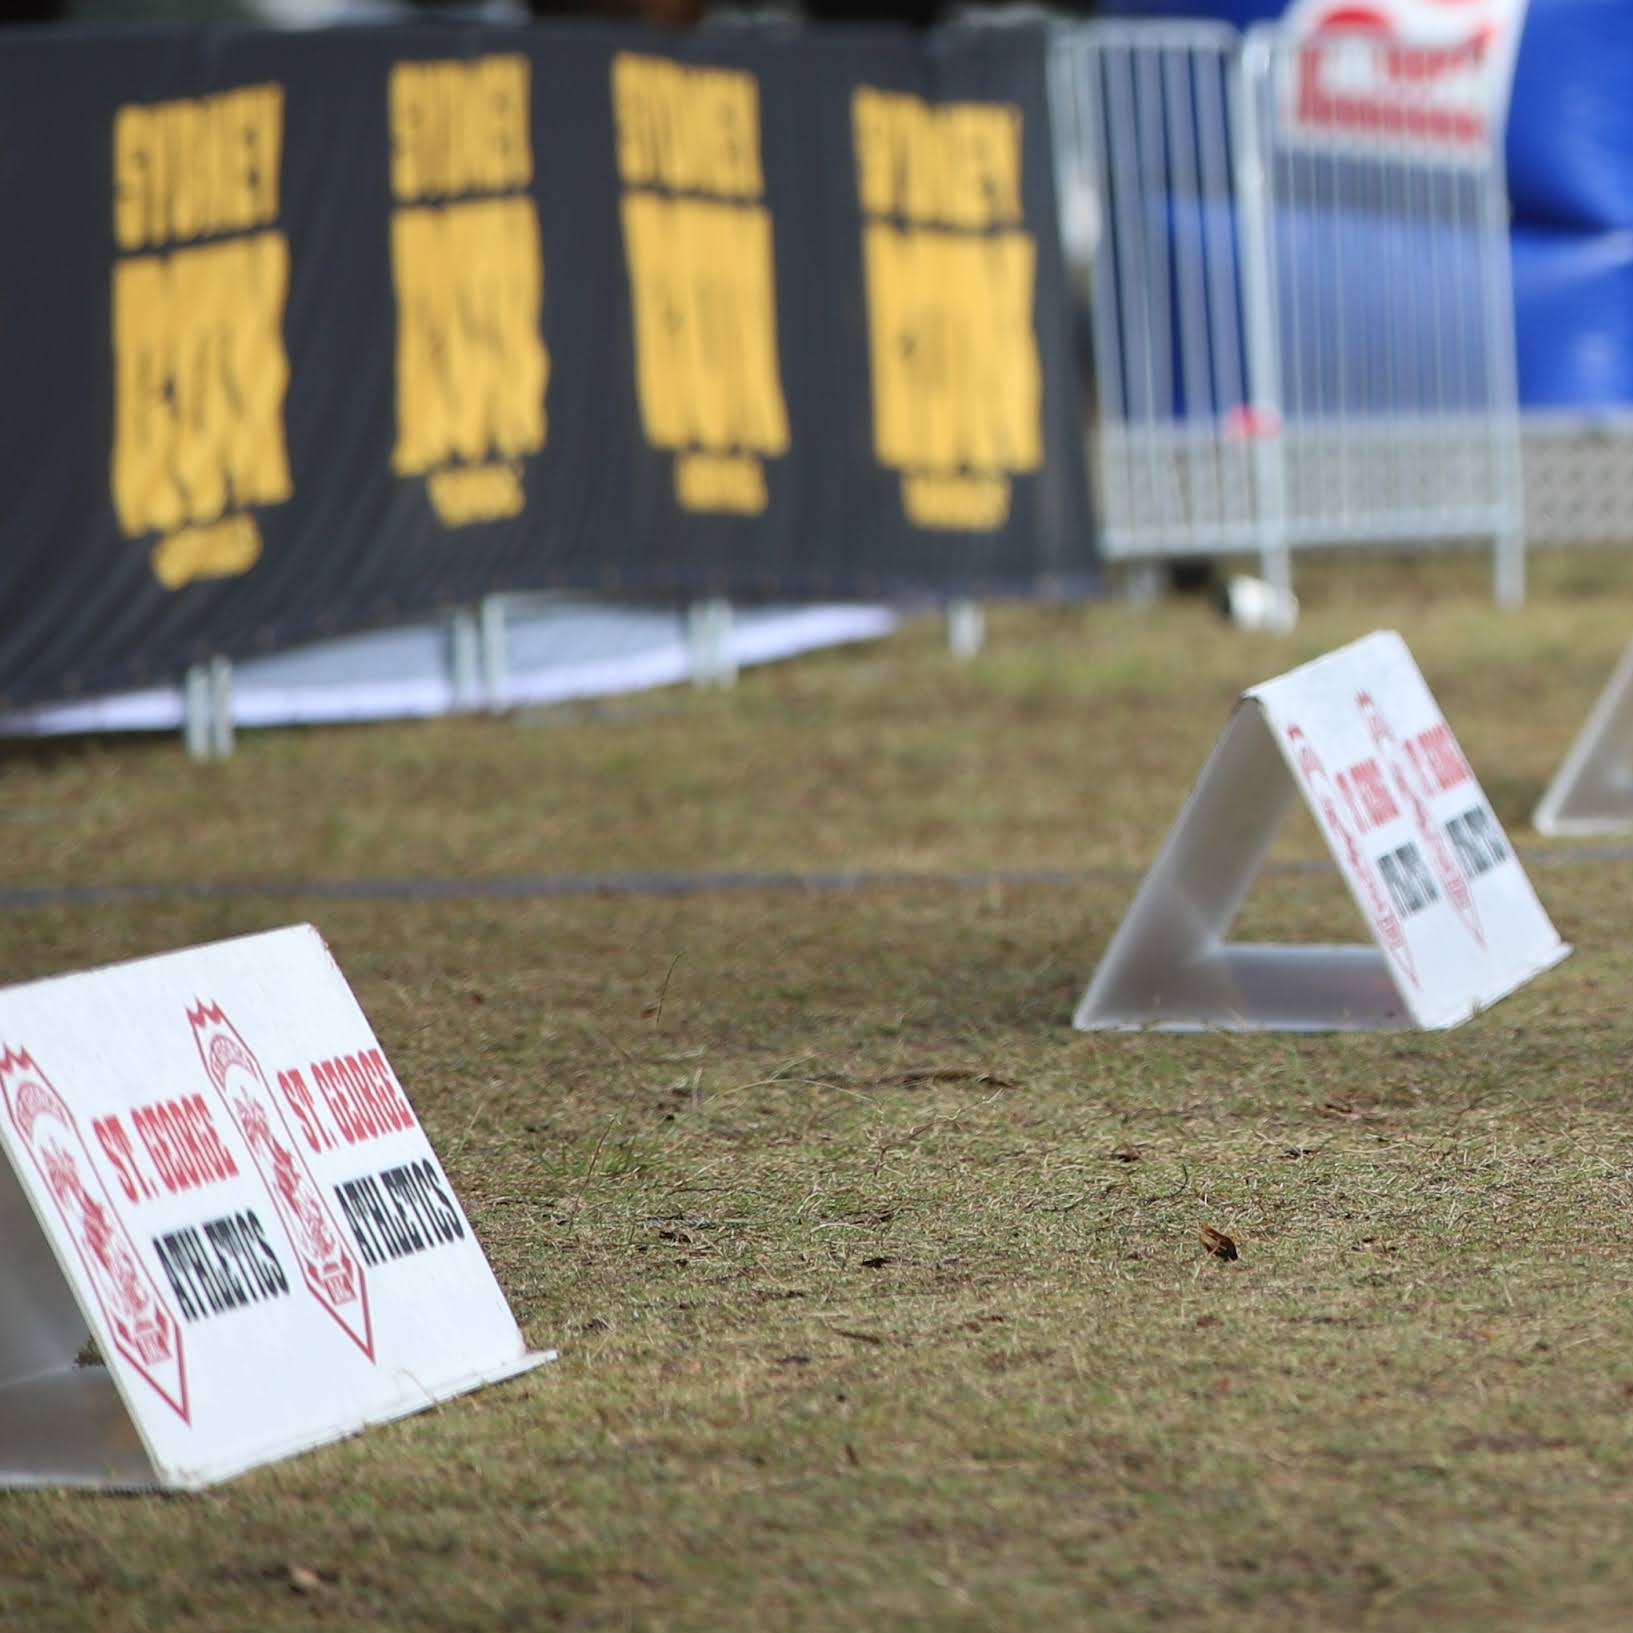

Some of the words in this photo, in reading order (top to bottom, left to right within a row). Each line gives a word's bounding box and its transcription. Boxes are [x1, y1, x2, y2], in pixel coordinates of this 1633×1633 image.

[92, 1113, 159, 1205] ST.
[130, 1092, 240, 1194] GEORGE
[276, 1067, 340, 1156] ST.
[310, 1047, 417, 1146] GEORGE
[152, 1207, 291, 1325] ATHLETICS
[333, 1157, 467, 1268] ATHLETICS
